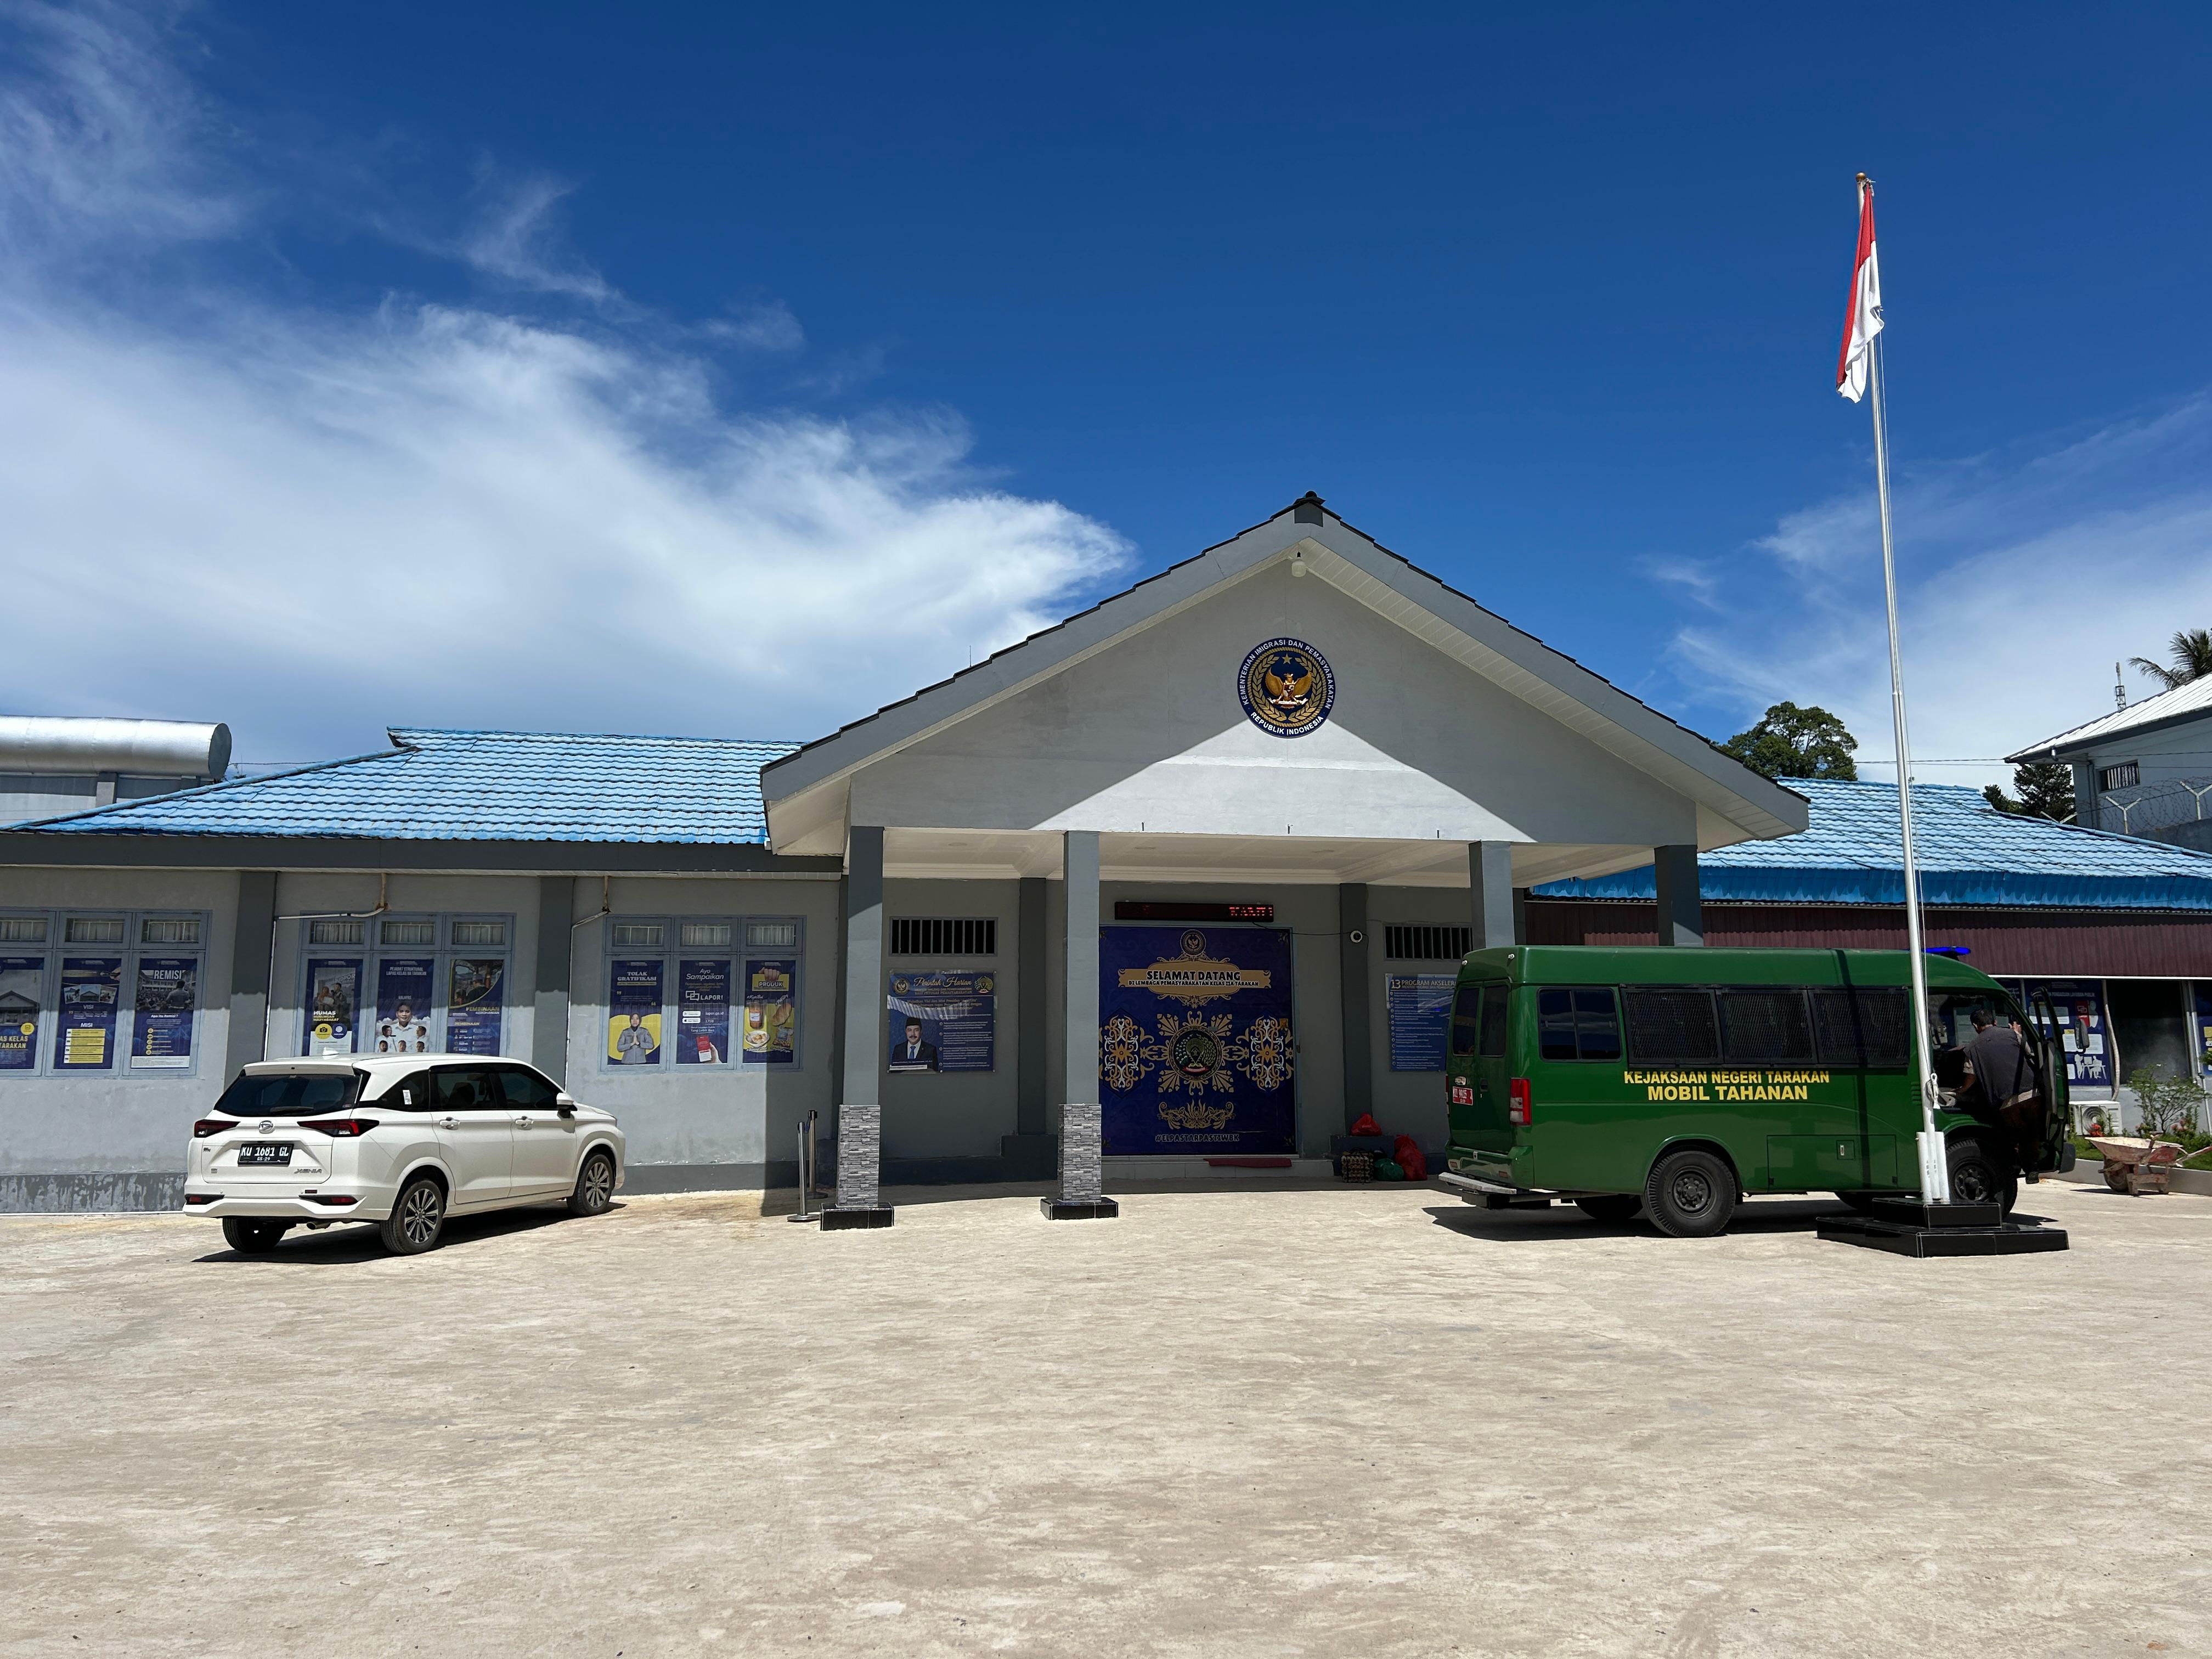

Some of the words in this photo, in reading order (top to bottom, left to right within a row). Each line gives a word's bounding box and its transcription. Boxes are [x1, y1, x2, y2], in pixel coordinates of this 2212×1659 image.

[1239, 654, 1255, 705] KEMENTERIAN
[1255, 640, 1285, 655] IMIGRASI
[1288, 640, 1304, 648] DAN
[1305, 645, 1334, 709] PEMASYARAKATAN
[1251, 712, 1284, 735] REPUBLIK
[1286, 716, 1324, 735] INDONESIA
[154, 970, 182, 980] REMISI
[1147, 970, 1195, 980] SELAMAT
[1198, 971, 1240, 981] DATANG
[913, 977, 941, 986] Perintah
[943, 977, 972, 987] Harian
[1391, 979, 1401, 989] 13
[1624, 1071, 1706, 1084] KEJAKSAAN
[1711, 1071, 1762, 1084] NEGERI
[1765, 1071, 1829, 1083] TARAKAN
[1647, 1086, 1710, 1101] MOBIL
[1715, 1085, 1808, 1101] TAHANAN
[1155, 1133, 1239, 1142] #ELPASTARPASTIWBK
[240, 1147, 252, 1156] KU
[254, 1147, 275, 1156] 1681
[279, 1147, 289, 1156] GL
